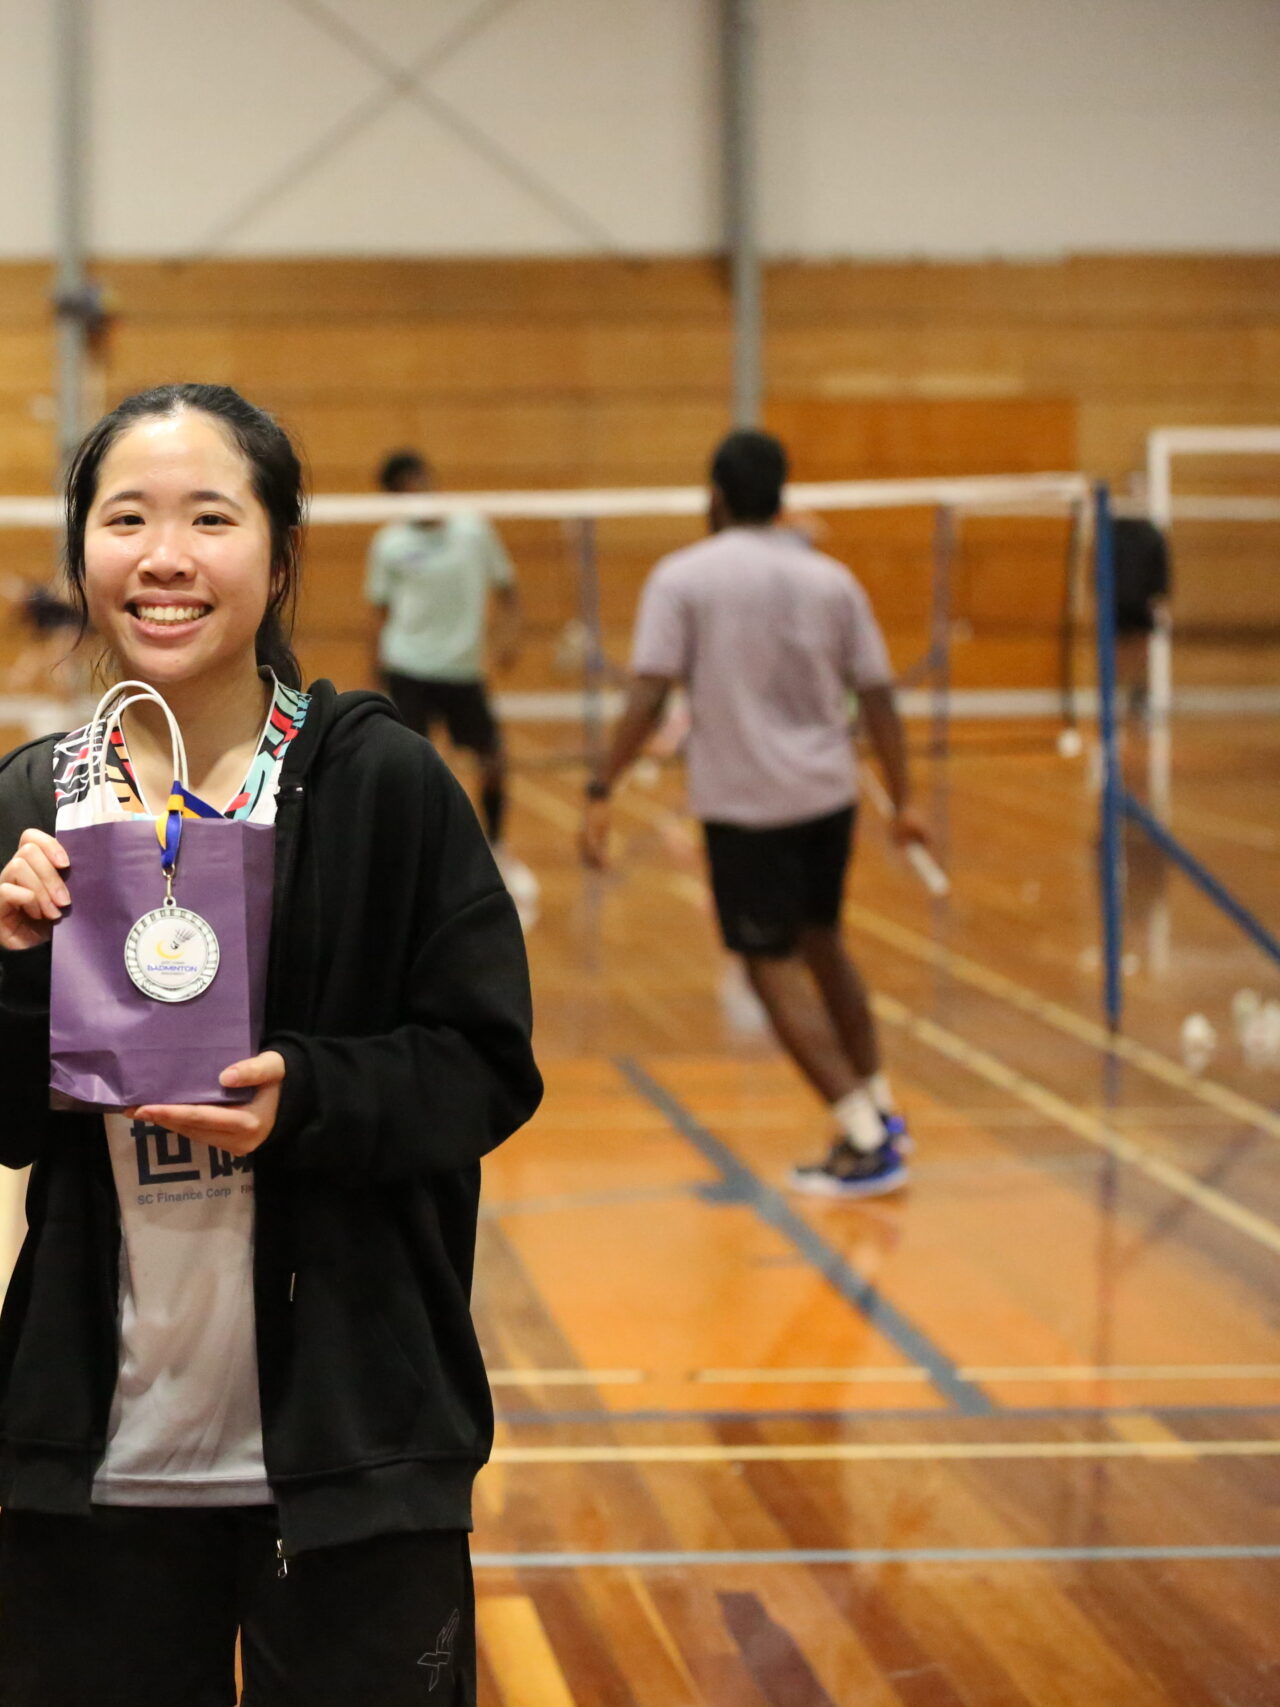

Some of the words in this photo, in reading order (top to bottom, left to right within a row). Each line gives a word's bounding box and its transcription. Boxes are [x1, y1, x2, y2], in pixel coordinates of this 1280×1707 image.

[137, 1193, 153, 1205] SC
[157, 1190, 203, 1203] Finance
[206, 1187, 231, 1199] Corp
